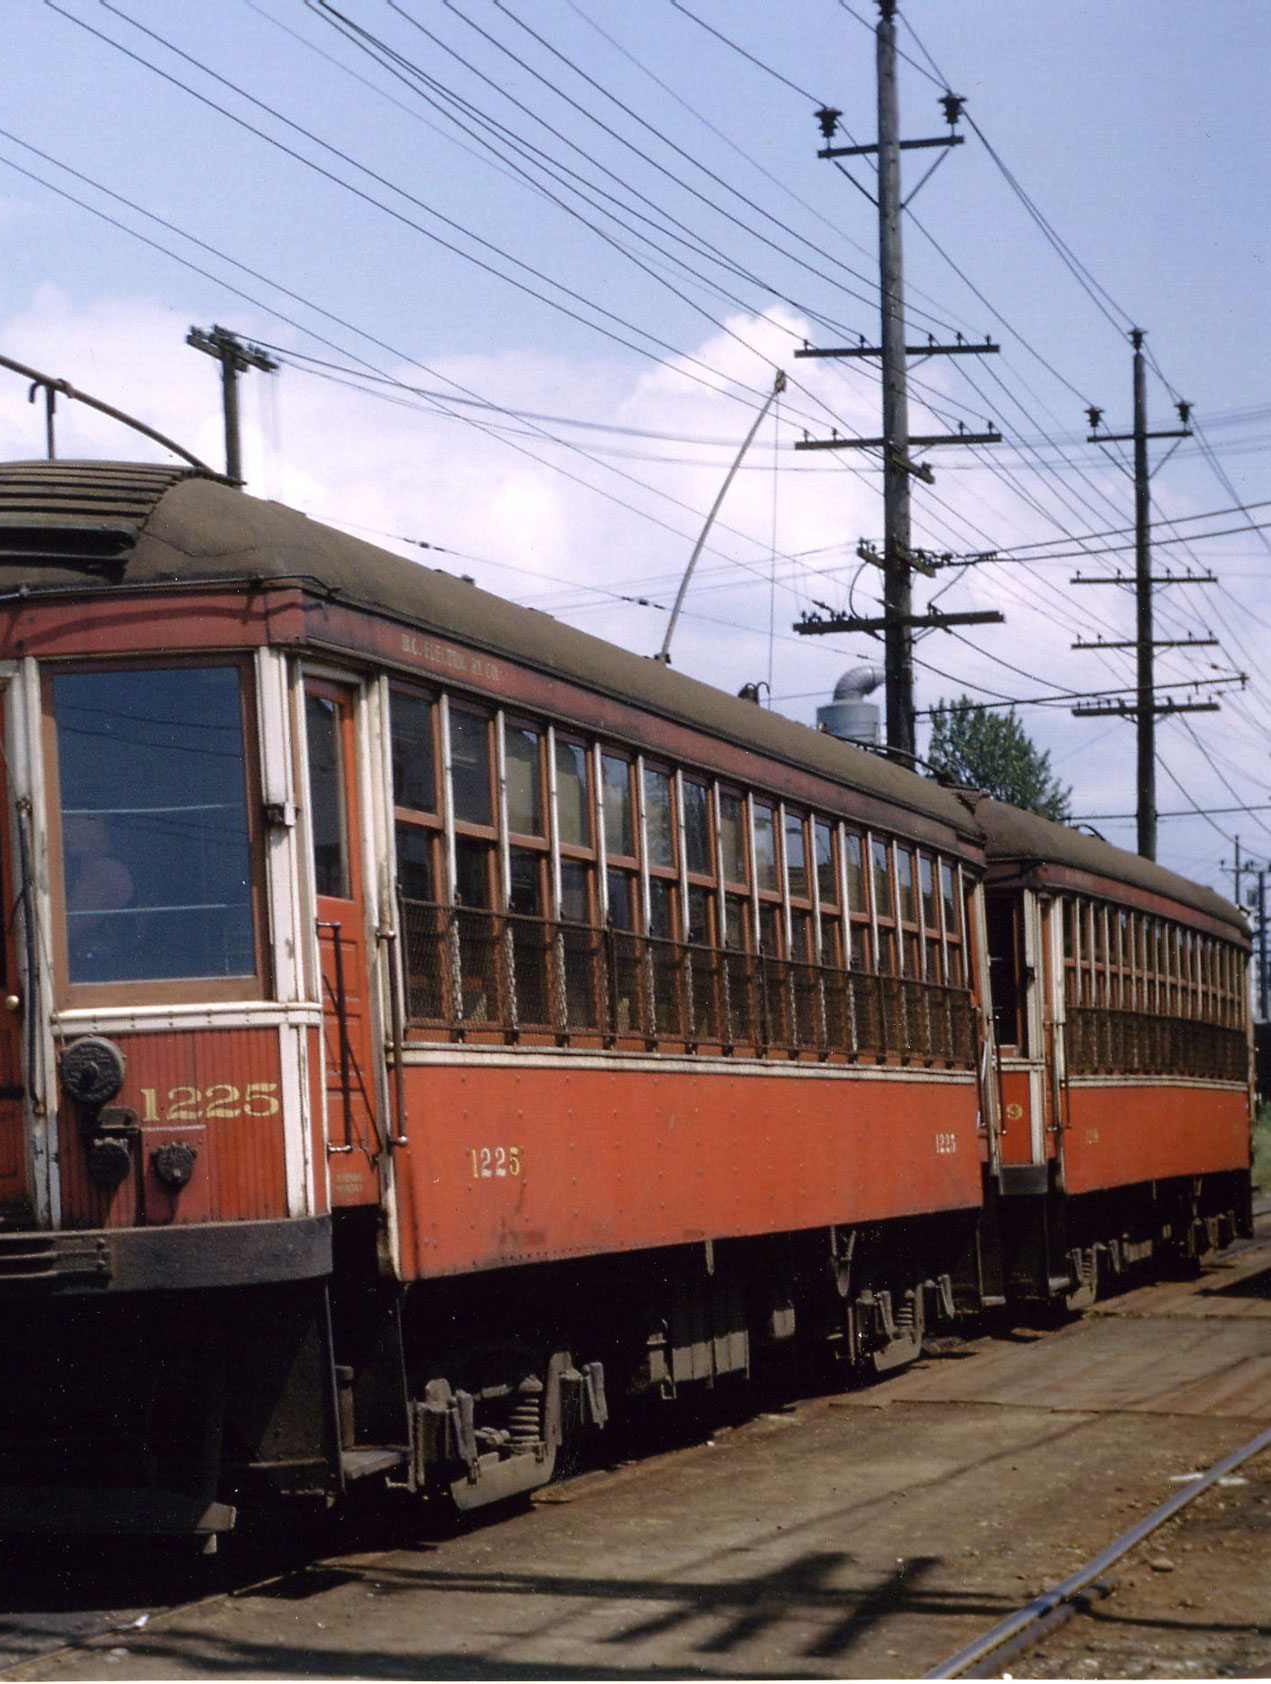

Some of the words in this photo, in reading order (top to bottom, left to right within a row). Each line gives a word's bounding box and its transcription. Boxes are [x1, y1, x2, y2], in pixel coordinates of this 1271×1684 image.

[140, 1083, 280, 1122] 1225
[935, 1133, 957, 1153] 1225
[471, 1146, 521, 1179] 1225
